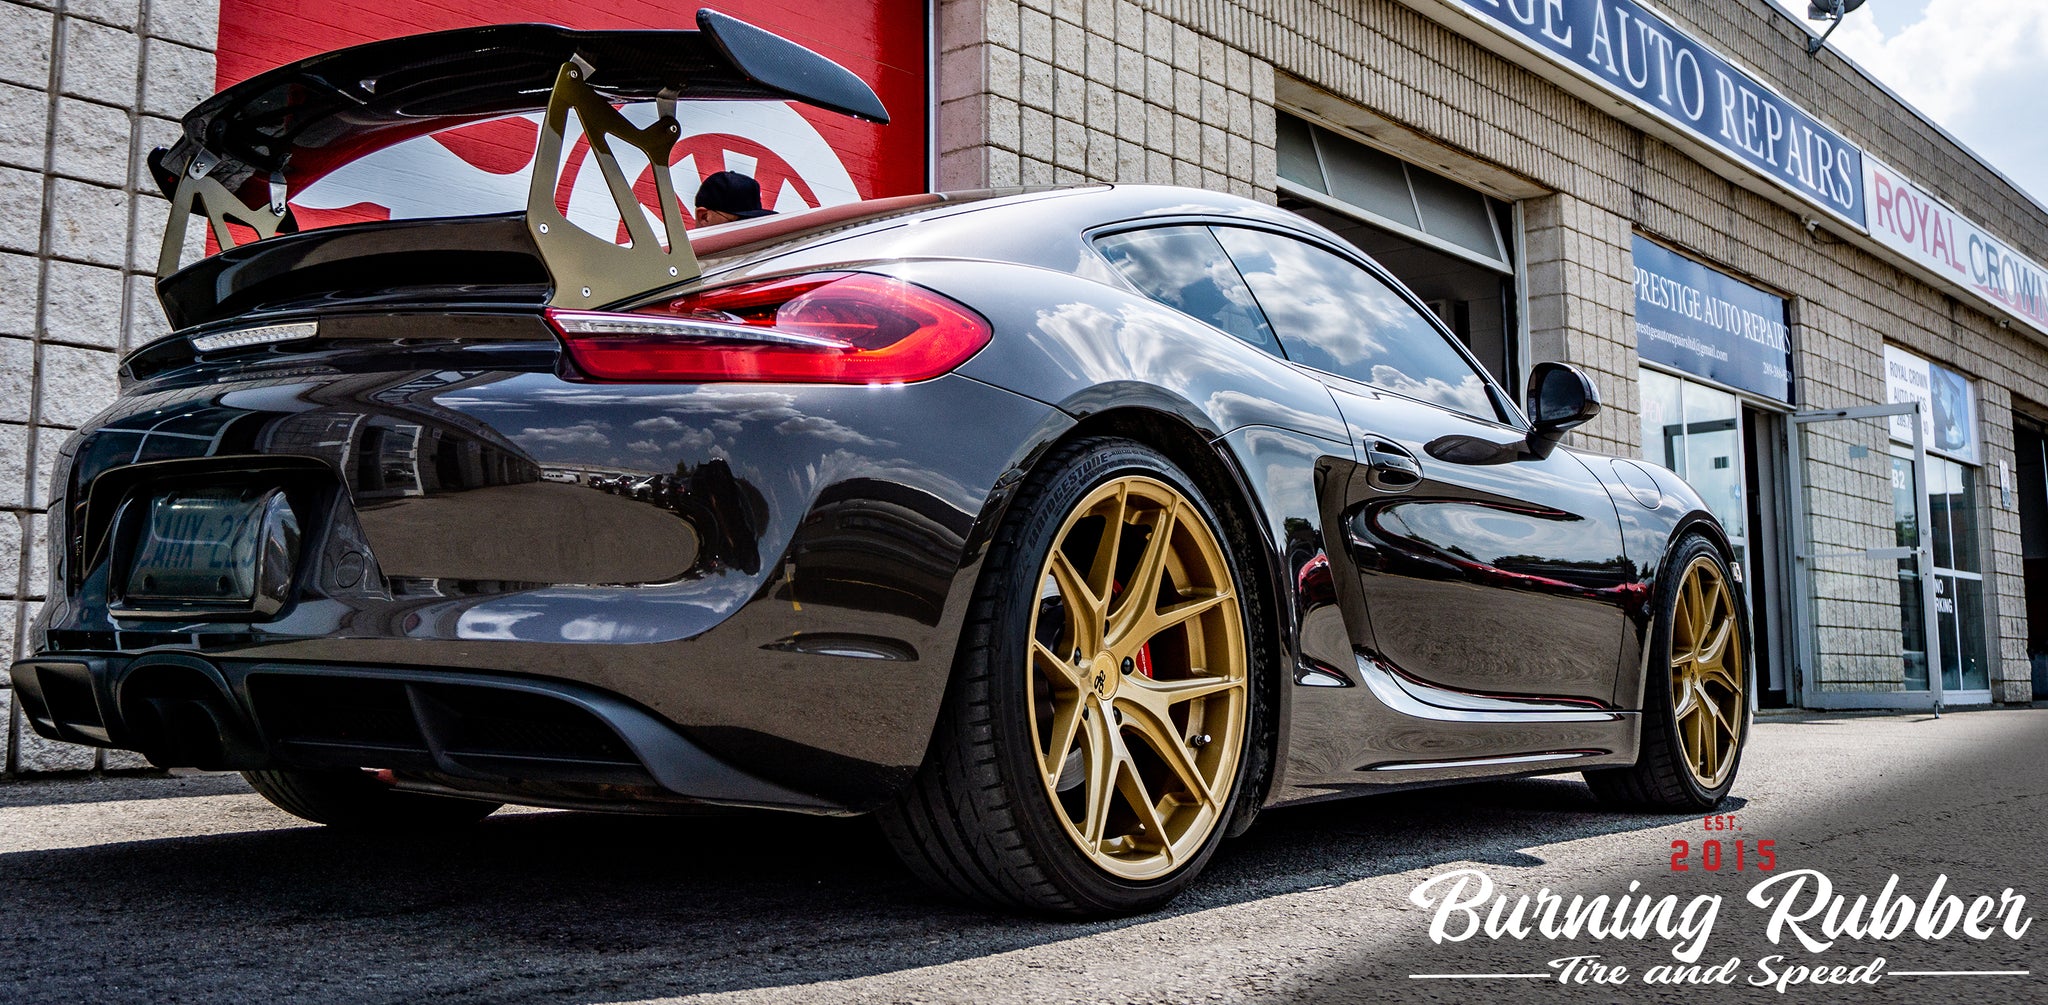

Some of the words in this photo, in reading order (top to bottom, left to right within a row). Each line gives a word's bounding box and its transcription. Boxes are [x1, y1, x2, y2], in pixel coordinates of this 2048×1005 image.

[1587, 0, 1705, 121] AUTO
[1715, 69, 1854, 210] REPAIRS
[1873, 170, 1967, 275] ROYAL
[1633, 265, 1703, 321] PRESTIGE
[1704, 295, 1742, 336] AUTO
[1743, 309, 1791, 355] REPAIRS
[1889, 361, 1908, 382] ROYAL
[1908, 368, 1929, 390] CROWN
[1028, 452, 1109, 548] BRIDGESTONE
[1891, 469, 1906, 490] B2
